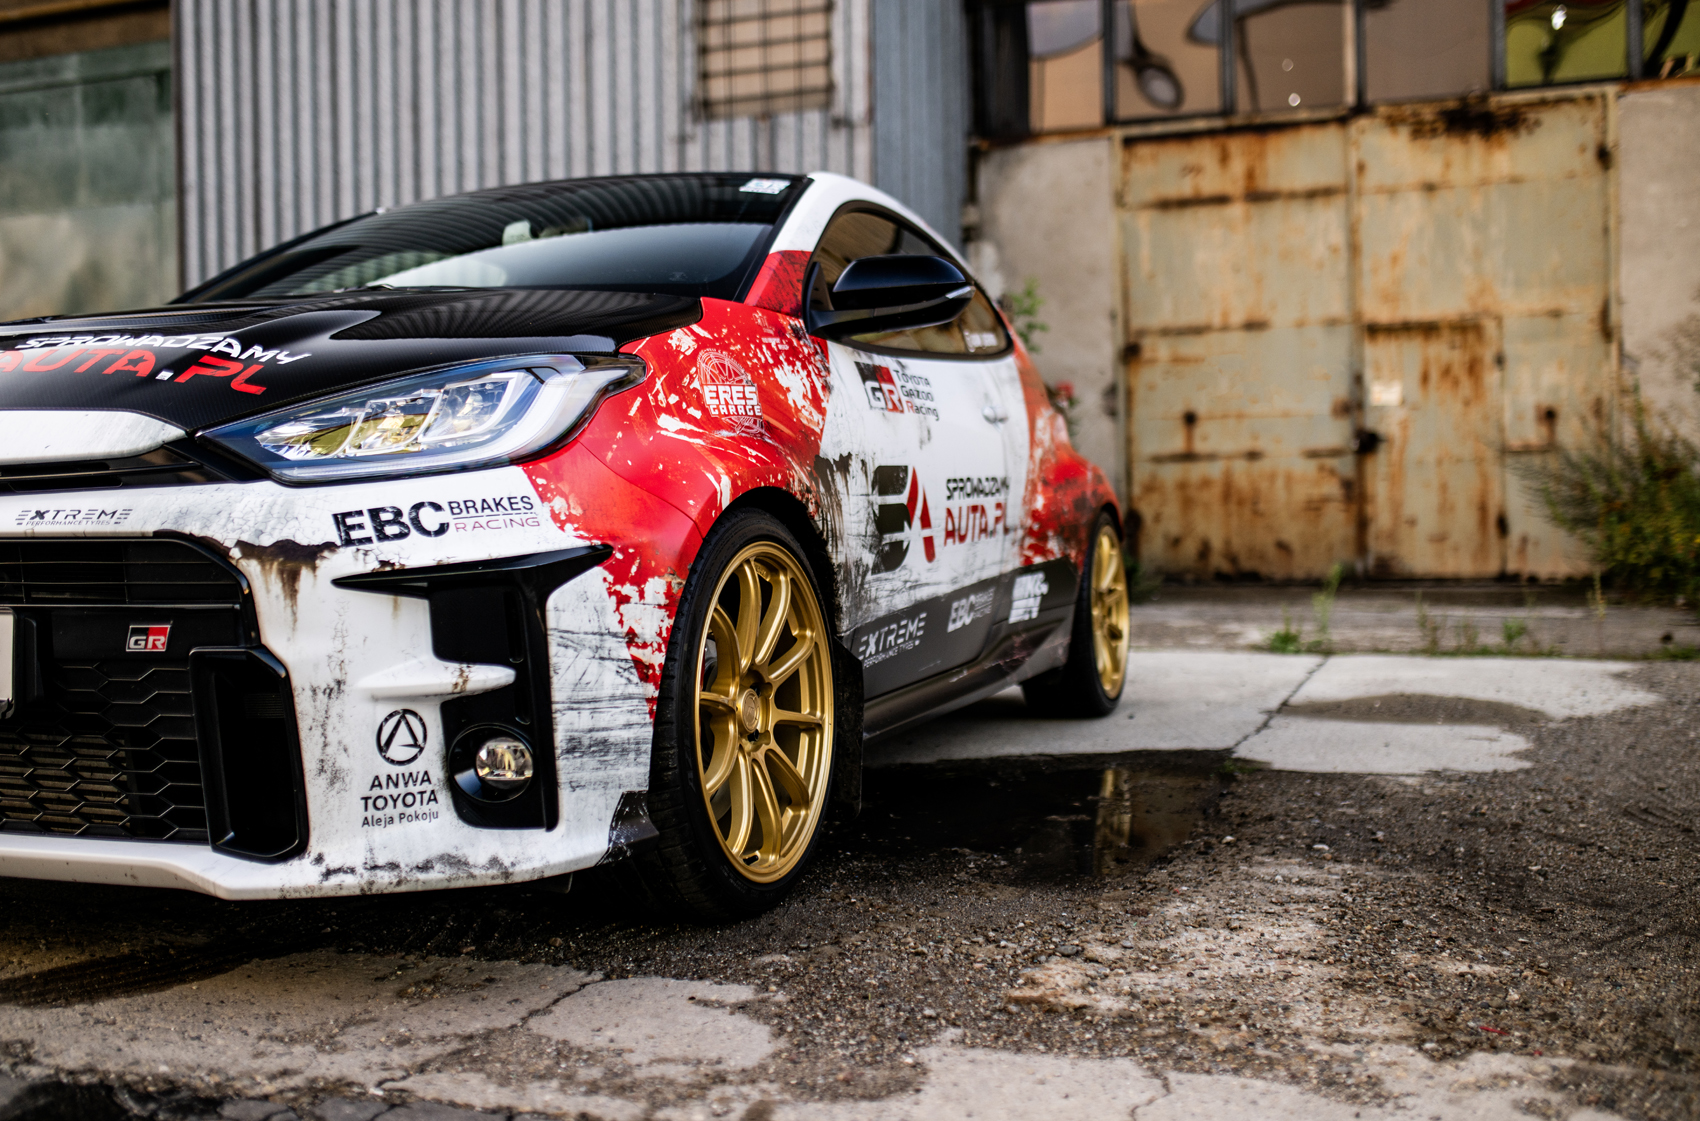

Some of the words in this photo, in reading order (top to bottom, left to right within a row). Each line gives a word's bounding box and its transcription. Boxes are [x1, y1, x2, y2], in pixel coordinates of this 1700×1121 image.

[15, 335, 312, 364] SPROWADZAMY
[893, 369, 932, 388] TOYOTA
[703, 385, 759, 406] ERES
[900, 385, 934, 402] GAZOO
[709, 405, 762, 416] GARAGE
[905, 400, 939, 421] Racing
[15, 509, 133, 520] EXTREME
[331, 501, 450, 548] EBC
[447, 495, 534, 516] BRAKES
[454, 517, 541, 532] RACING
[947, 594, 976, 634] EBC
[858, 612, 928, 661] EXTREME
[369, 770, 432, 791] ANWA
[360, 789, 439, 812] TOYOTA
[361, 814, 394, 829] Aleja
[399, 808, 439, 824] Pokoju
